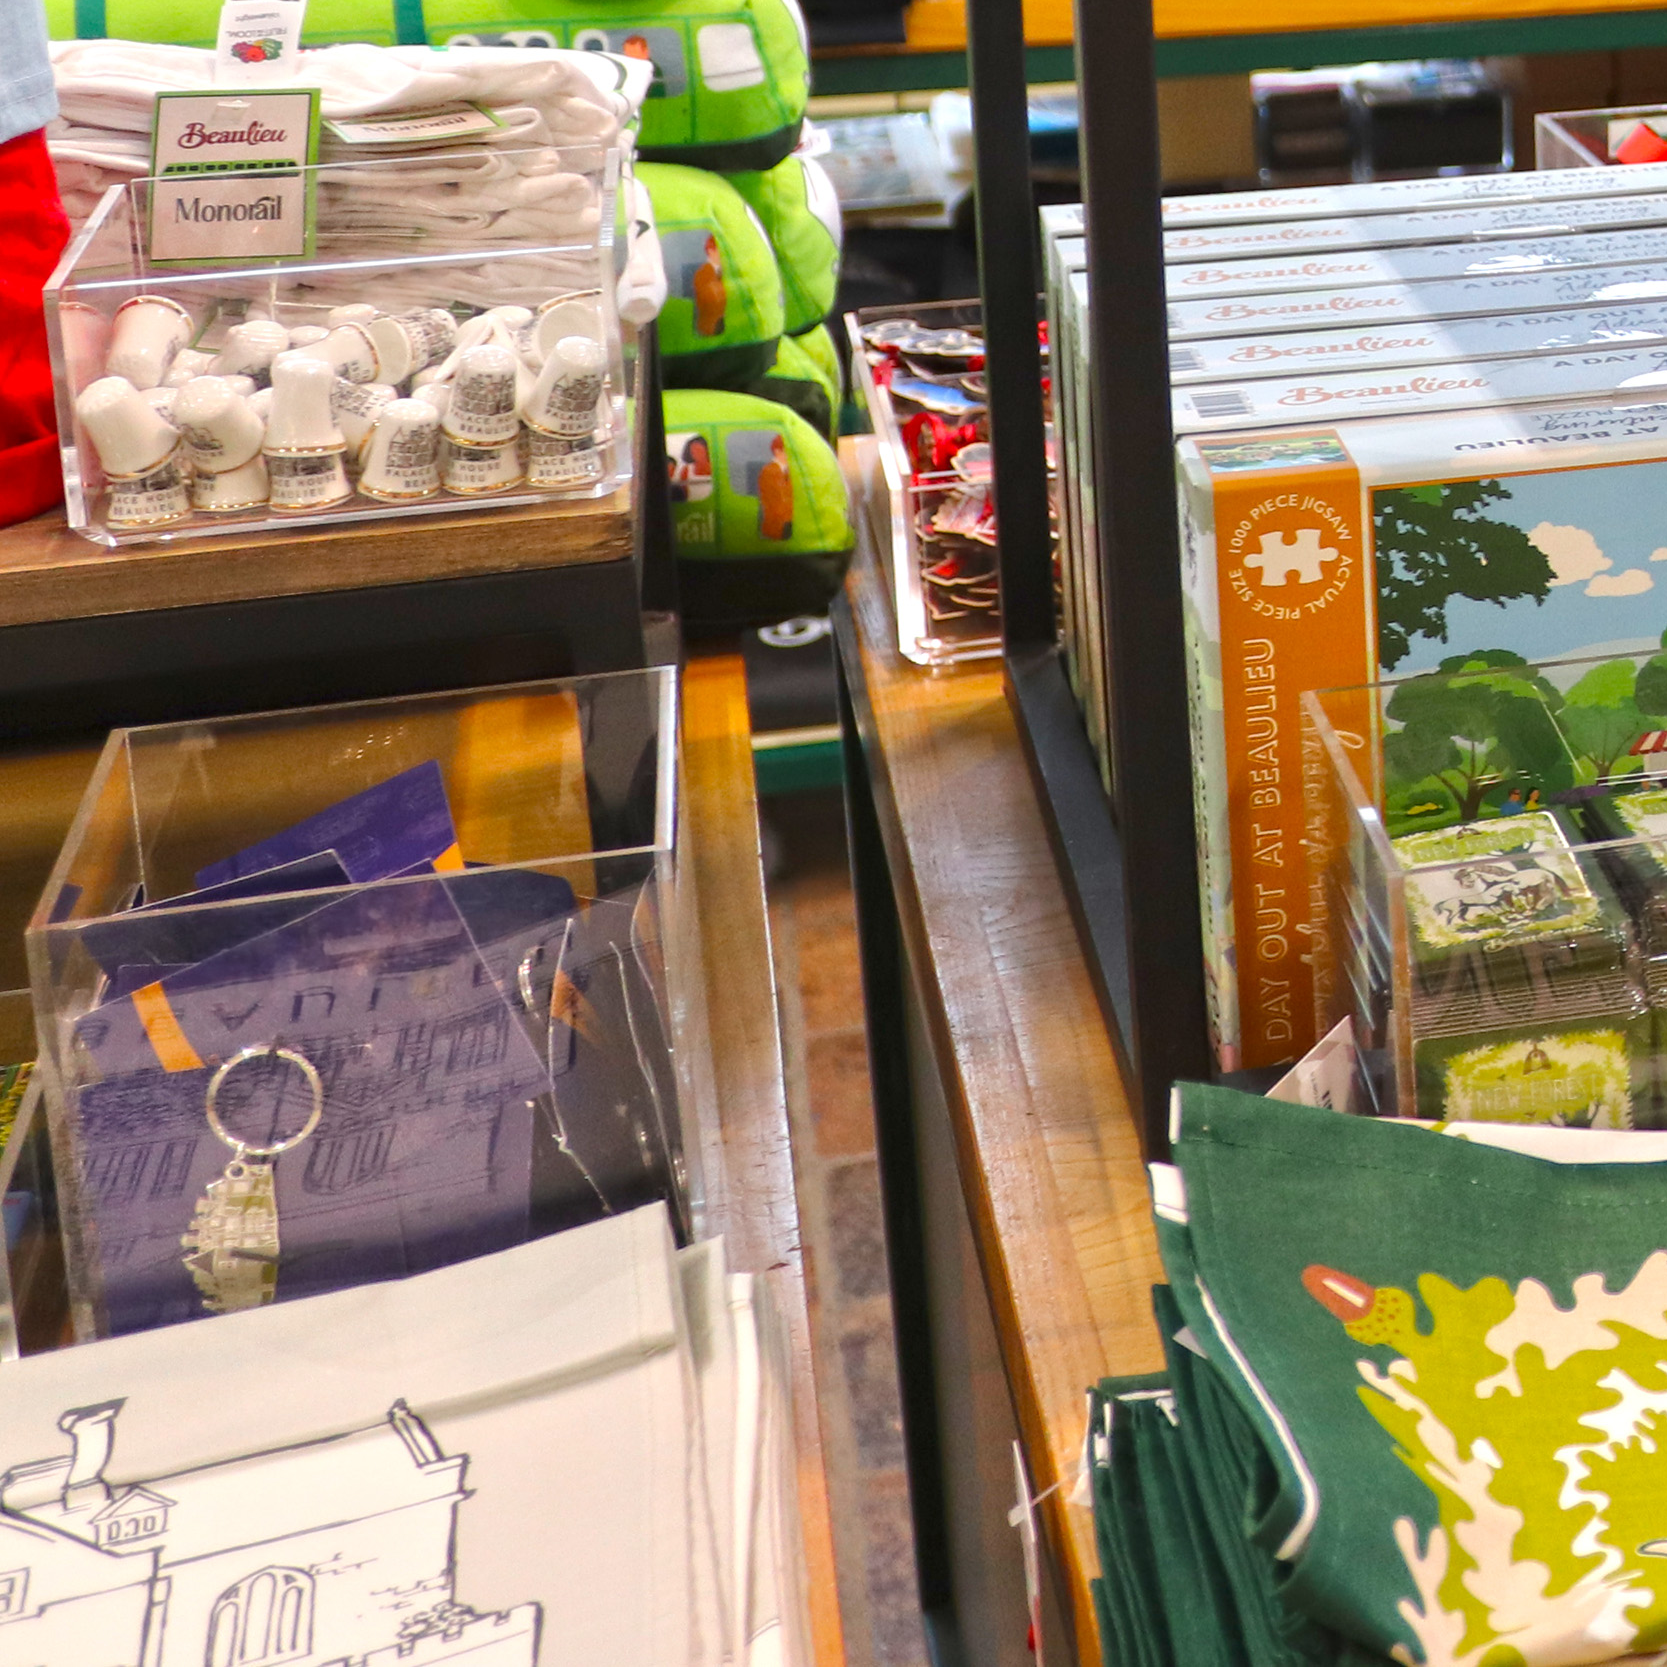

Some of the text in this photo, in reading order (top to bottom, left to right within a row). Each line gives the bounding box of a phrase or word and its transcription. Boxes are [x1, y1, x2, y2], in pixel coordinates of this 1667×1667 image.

[178, 121, 287, 149] Beaulieu
[176, 196, 281, 224] Monorail
[1277, 374, 1490, 406] Beaulieu
[1229, 494, 1352, 553] 1000 PIECE JIGSAW
[1229, 555, 1353, 619] ACTUAL PIECE SIZE
[1244, 638, 1293, 1041] DAY OUT AT BEAULIEU
